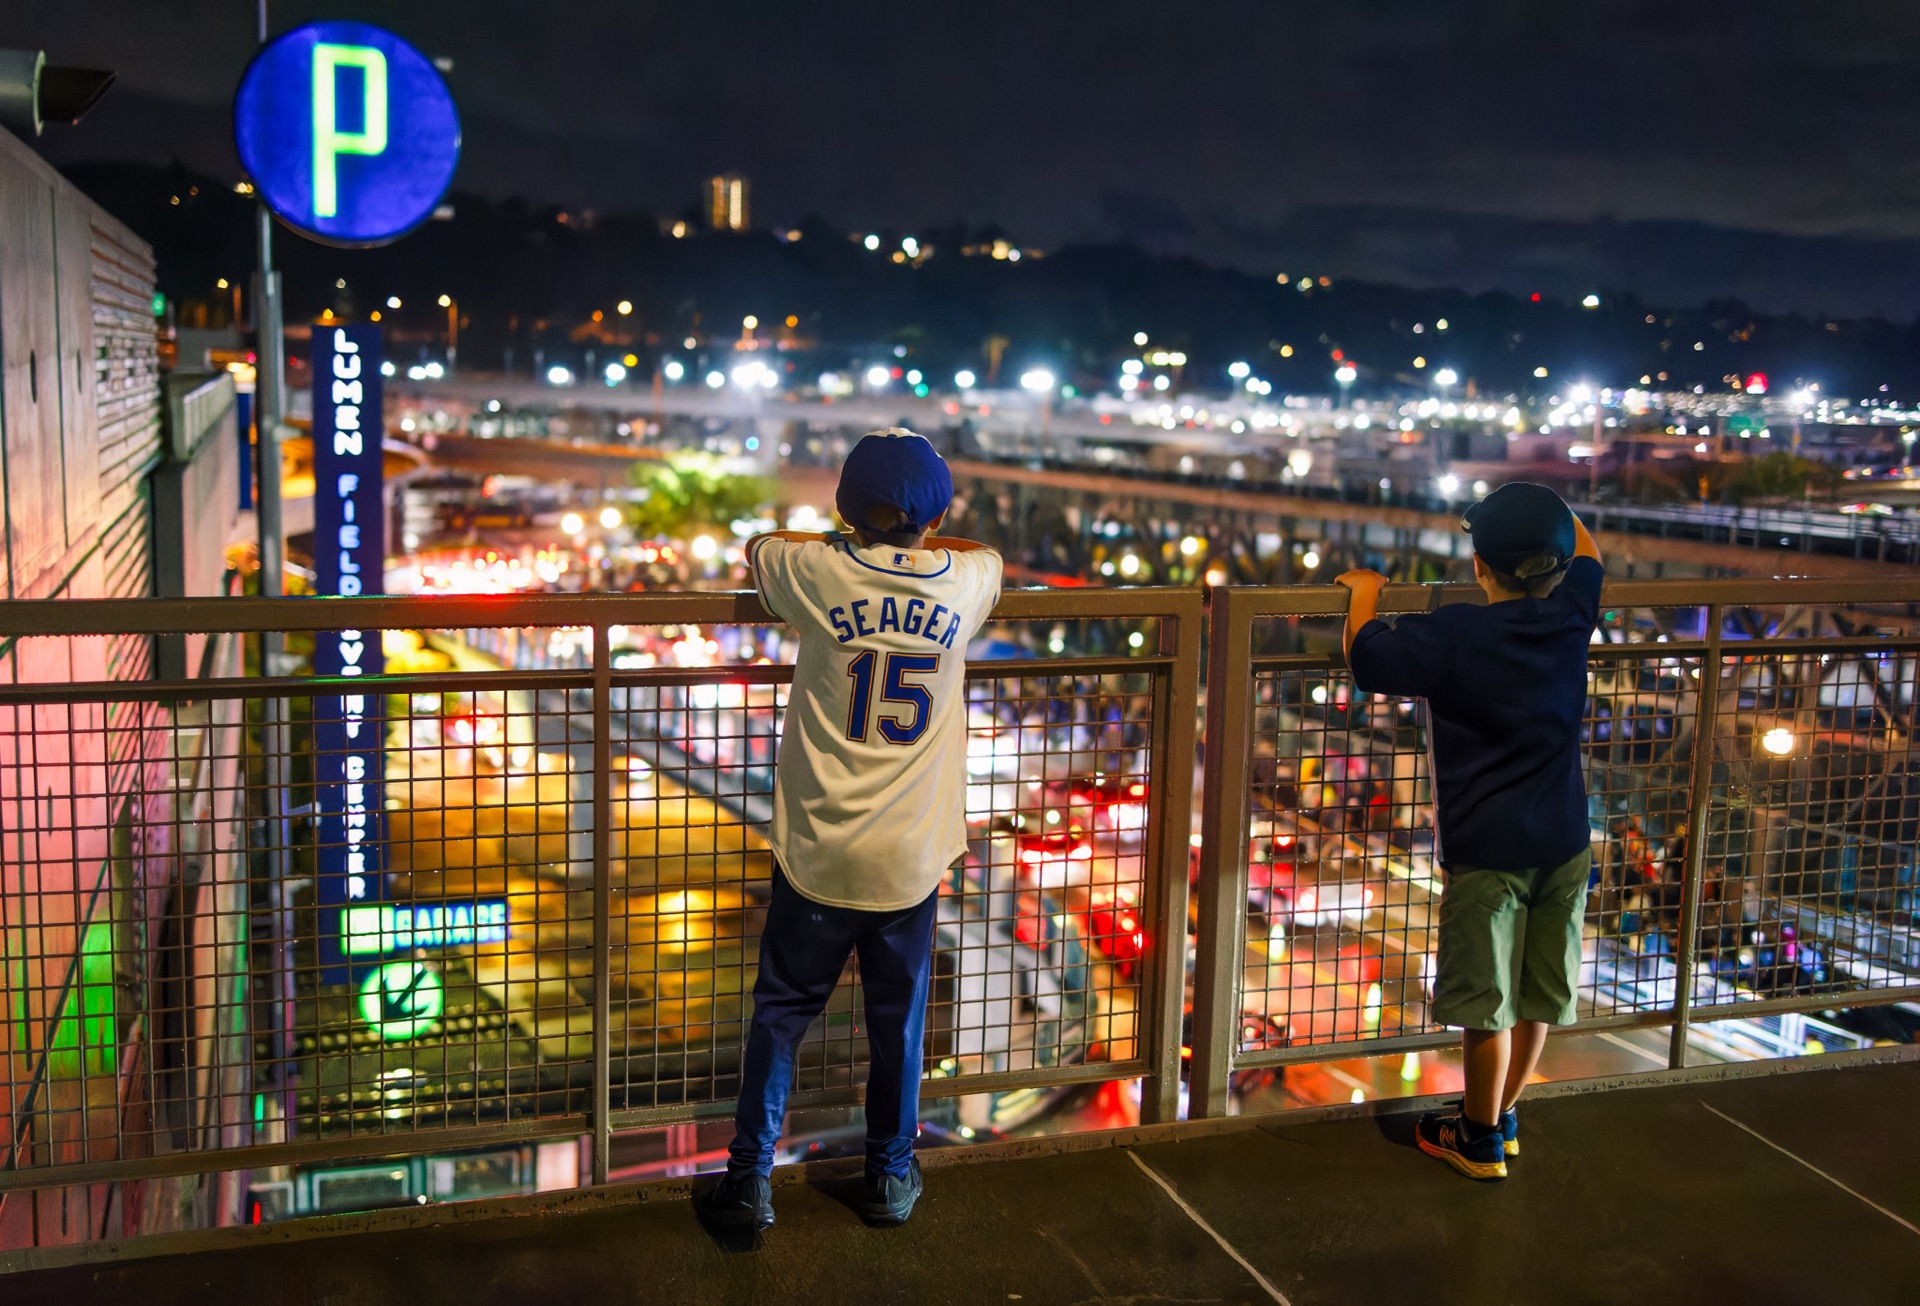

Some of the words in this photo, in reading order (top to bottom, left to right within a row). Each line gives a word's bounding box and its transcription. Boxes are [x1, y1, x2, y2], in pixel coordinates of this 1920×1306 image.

[313, 43, 388, 217] P
[332, 328, 363, 455] LUMEN
[338, 474, 362, 596] FIELD
[829, 597, 961, 650] SEAGER
[846, 650, 940, 746] 15
[395, 903, 508, 948] GARAGE
